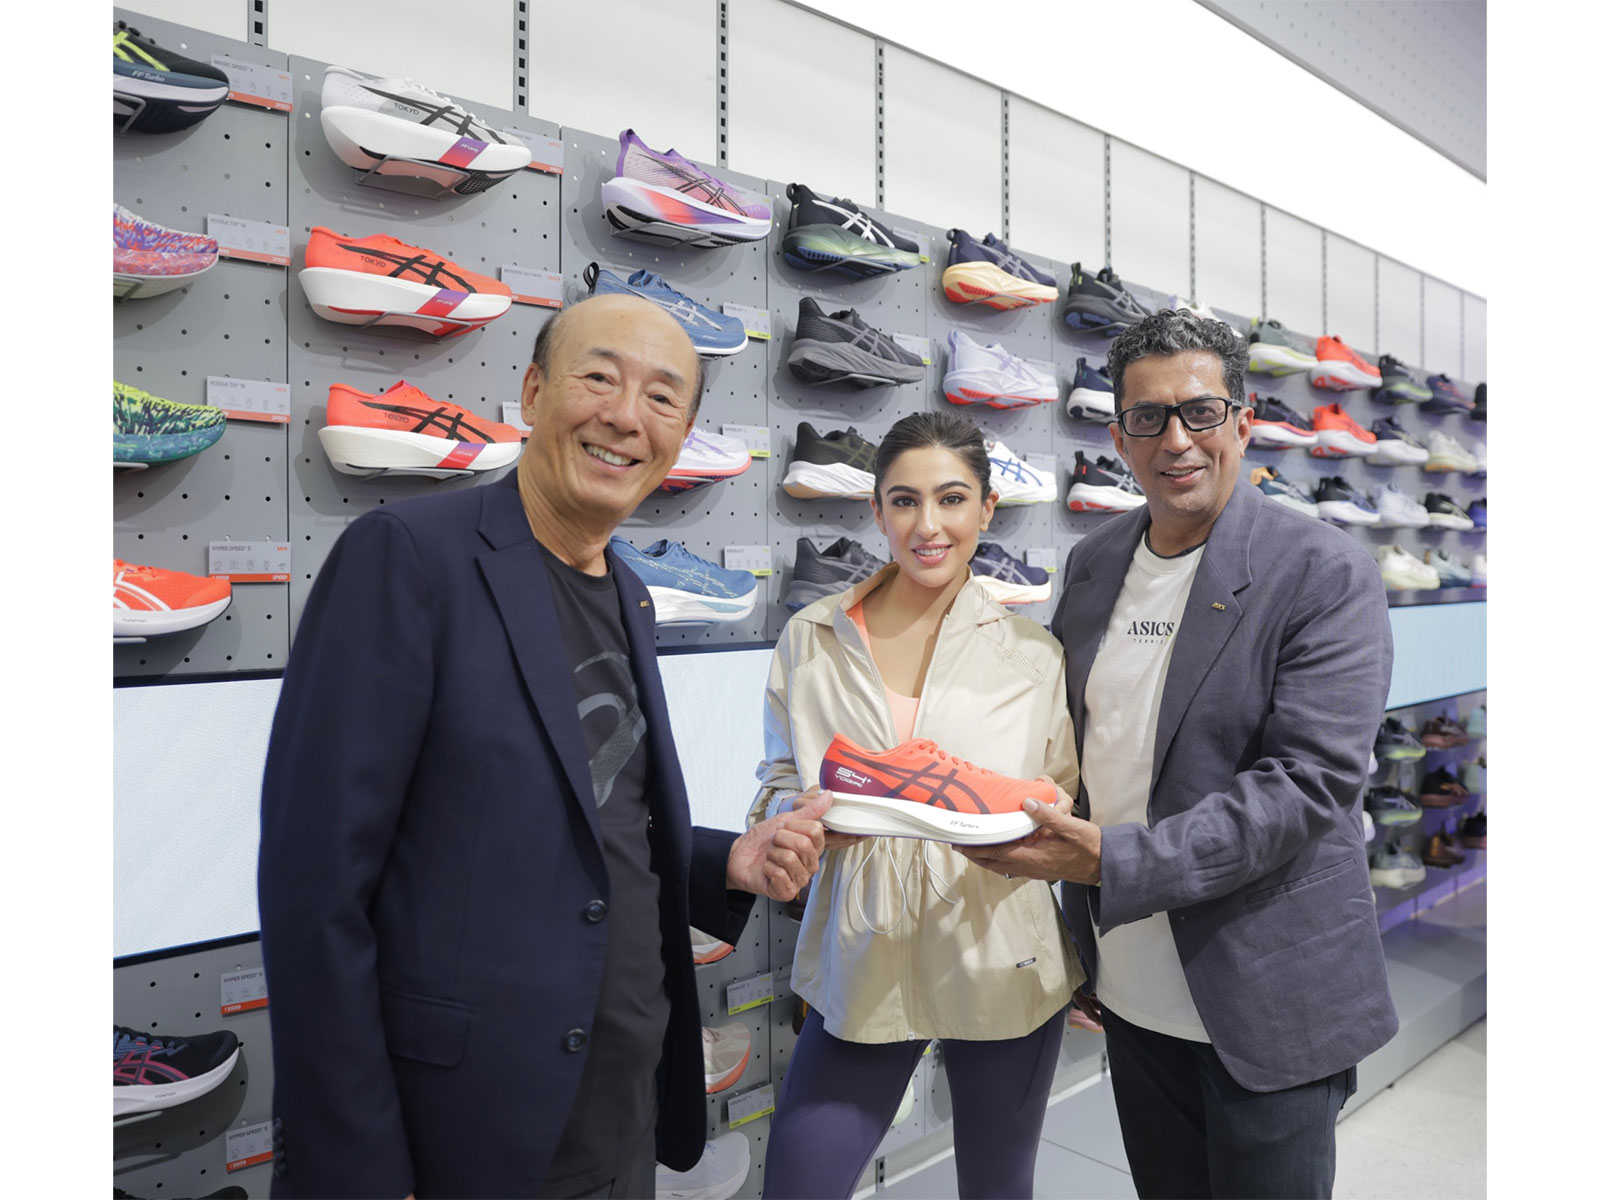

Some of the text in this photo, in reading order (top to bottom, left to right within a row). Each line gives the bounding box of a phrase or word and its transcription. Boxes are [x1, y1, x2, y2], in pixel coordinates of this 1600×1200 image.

[144, 72, 165, 82] Turbo
[394, 102, 420, 116] TOKYO
[360, 255, 386, 268] TOKYO
[384, 412, 410, 424] TOKYO
[1127, 621, 1175, 636] ASICS
[228, 1132, 245, 1140] HYPER
